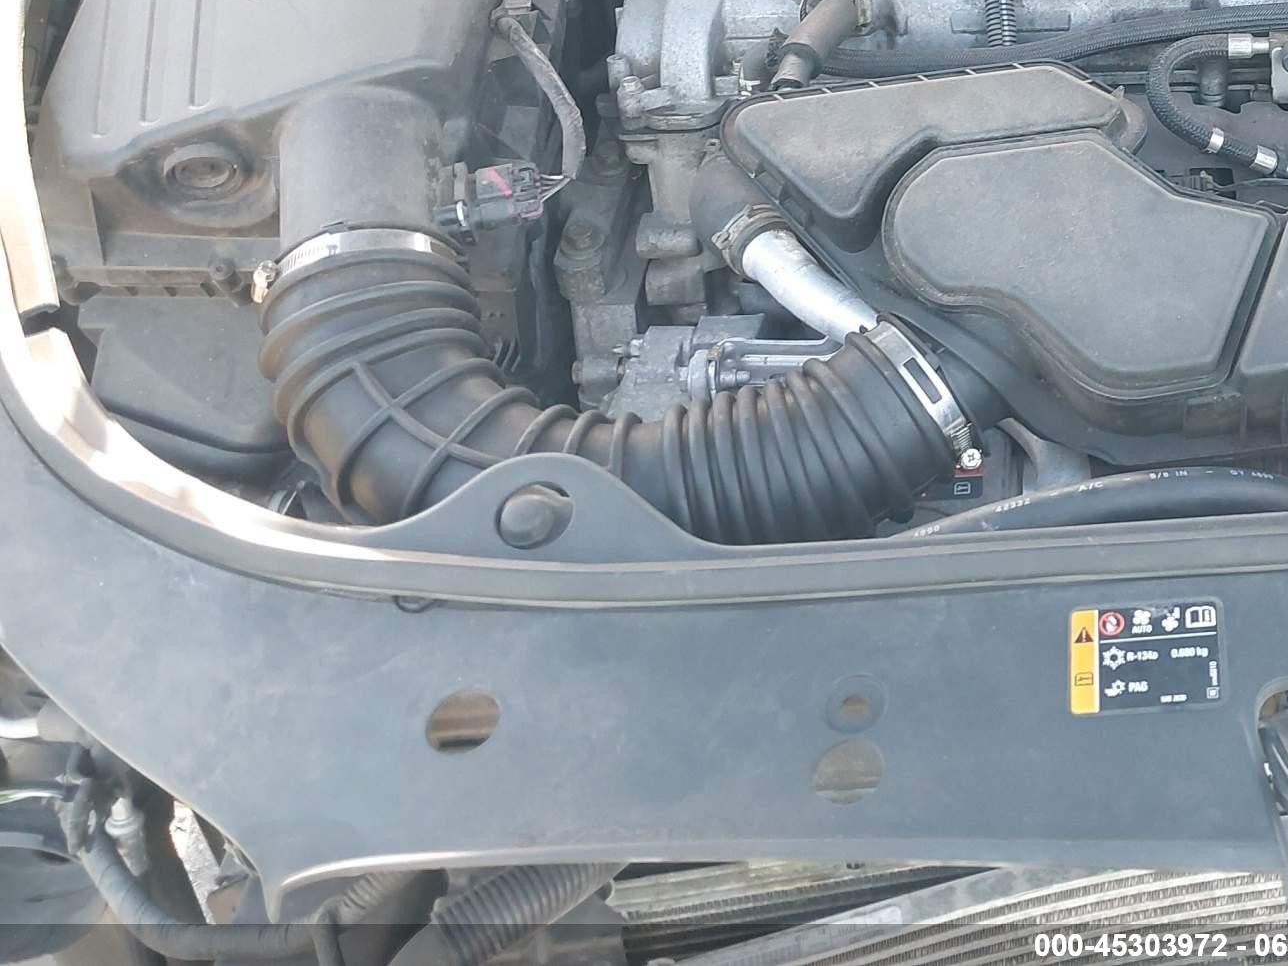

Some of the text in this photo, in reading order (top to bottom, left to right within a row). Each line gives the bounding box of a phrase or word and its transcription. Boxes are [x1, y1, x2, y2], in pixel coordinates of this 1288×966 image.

[1078, 481, 1103, 492] A/C
[1132, 625, 1152, 634] AUTO
[1128, 681, 1148, 692] PAG
